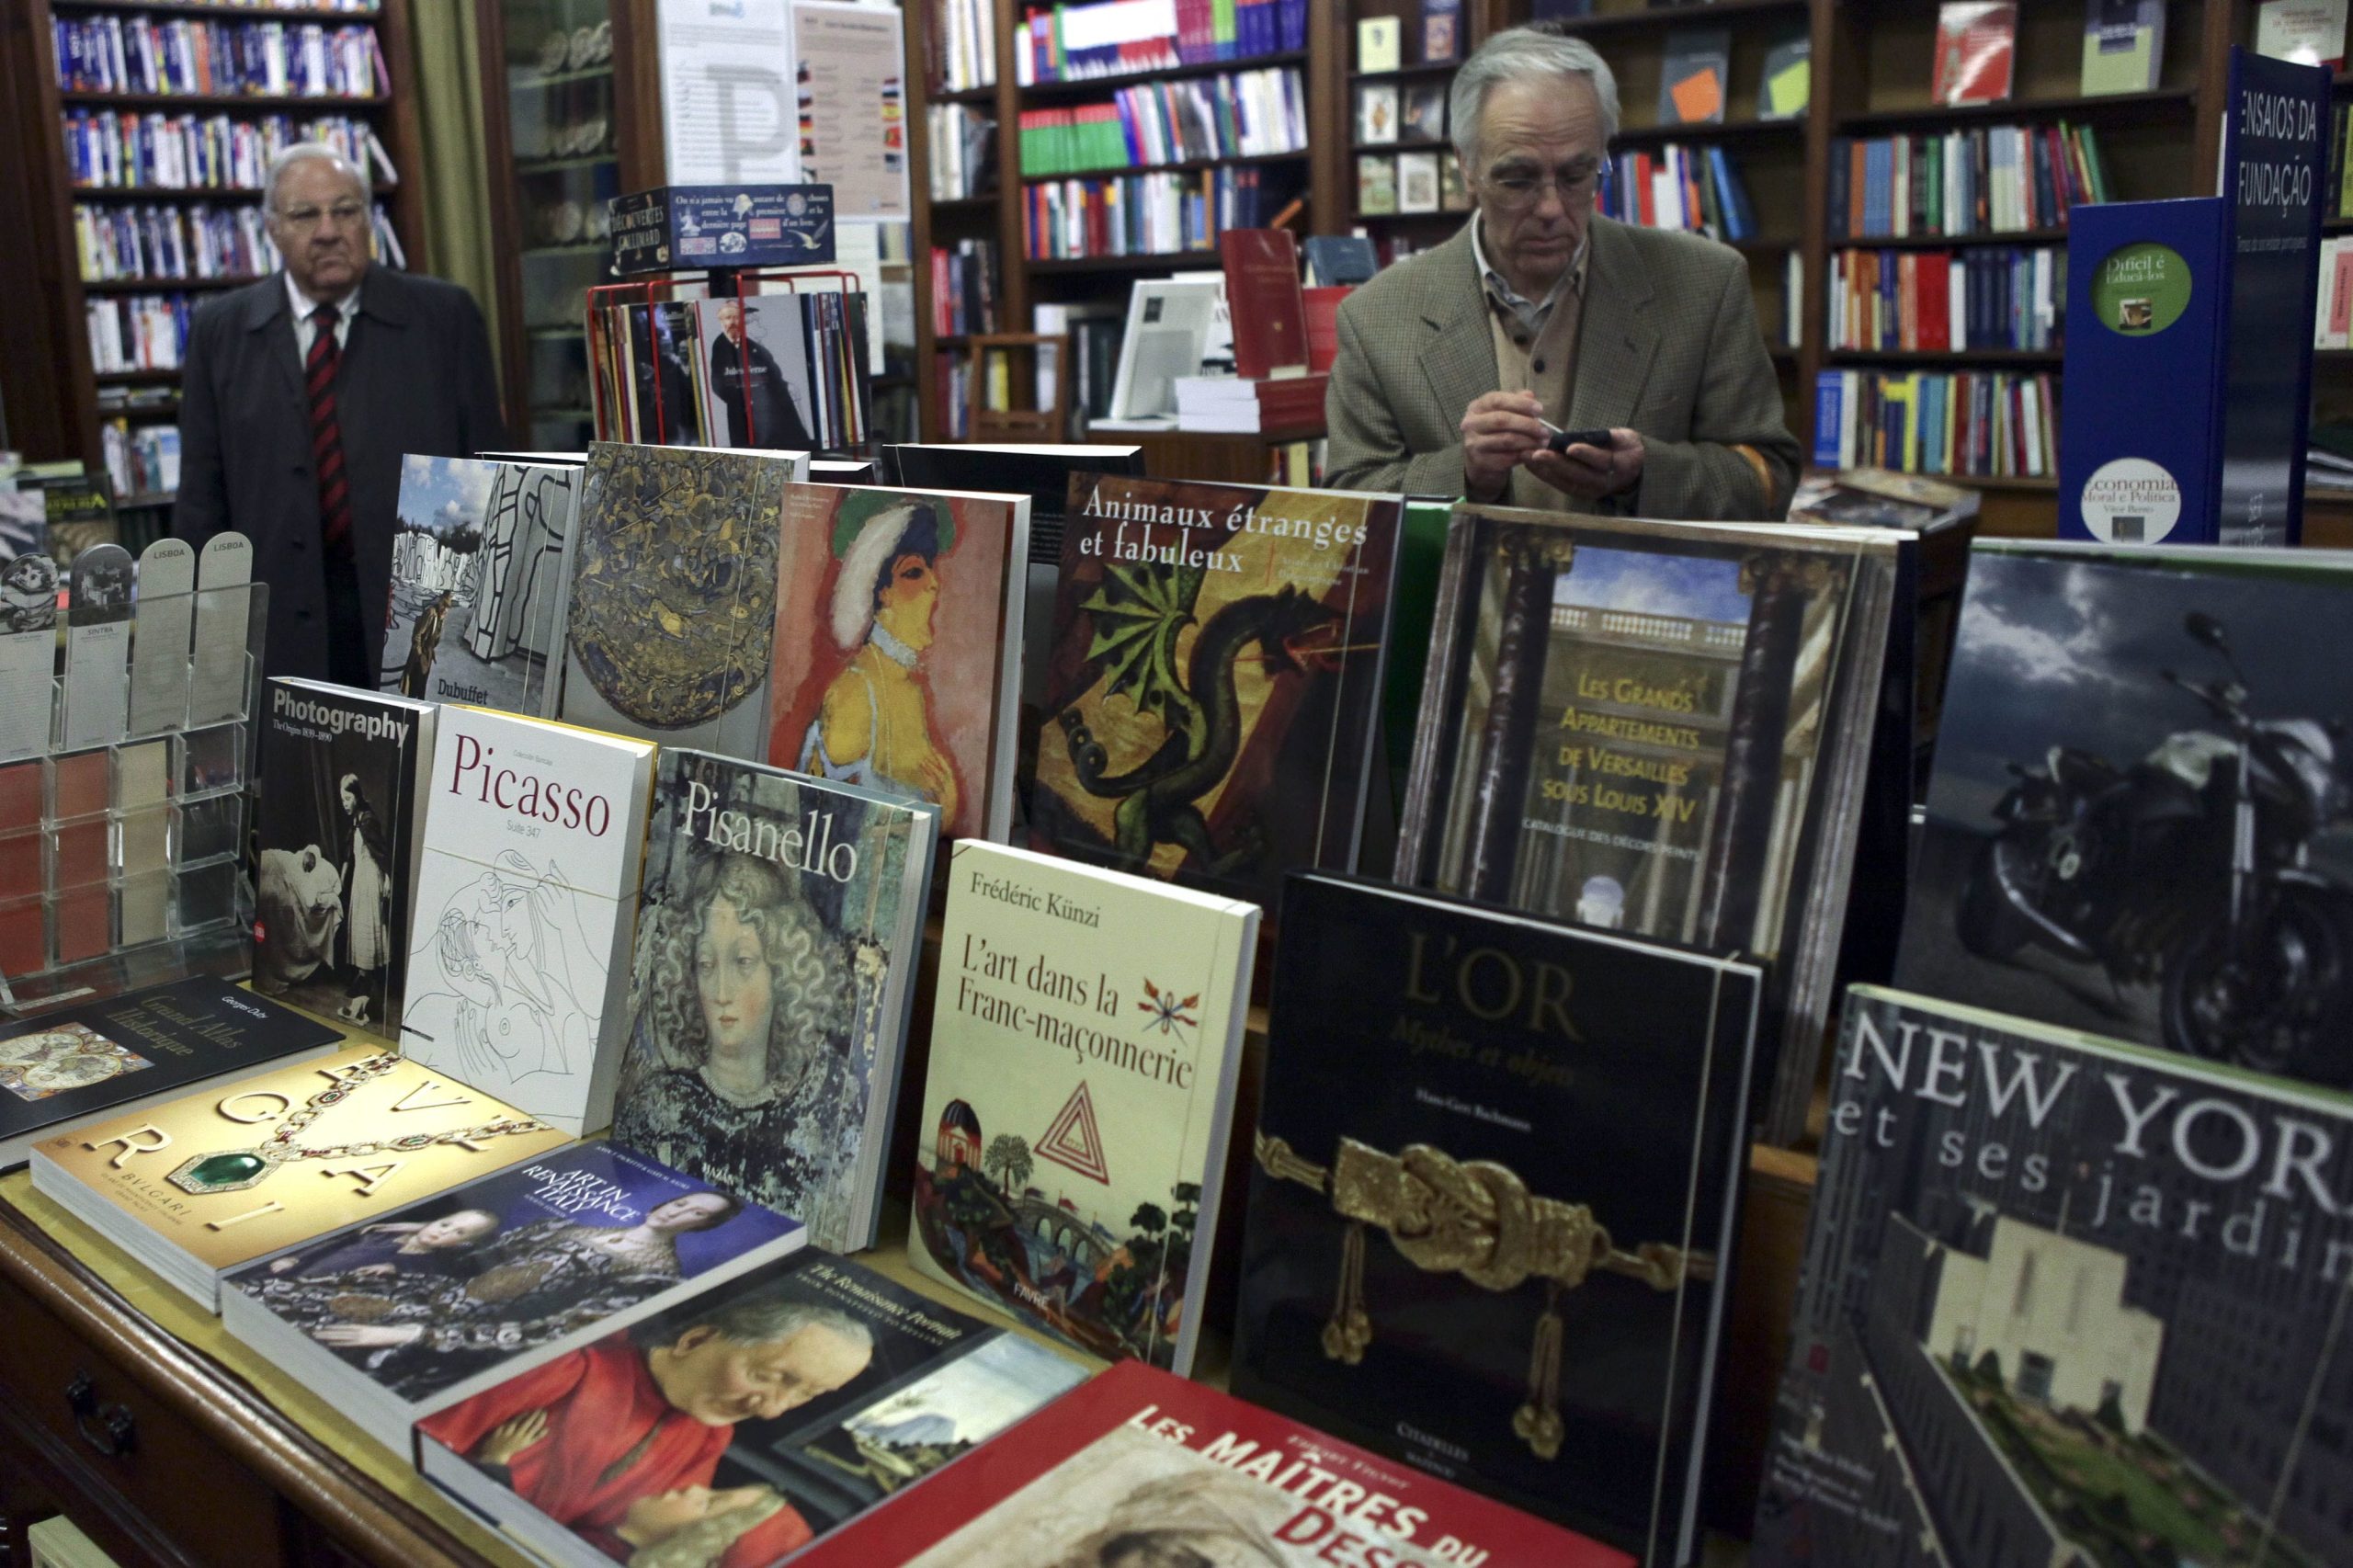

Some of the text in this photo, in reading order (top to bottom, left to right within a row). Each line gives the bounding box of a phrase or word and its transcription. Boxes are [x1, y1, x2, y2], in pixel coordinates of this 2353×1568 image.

[2298, 99, 2316, 142] DA
[676, 196, 689, 205] On
[754, 195, 775, 204] autant
[776, 195, 784, 203] de
[2237, 154, 2312, 218] FUNDAÇÃO
[701, 209, 720, 217] entre
[721, 207, 727, 216] la
[2156, 255, 2165, 268] é
[1083, 484, 1369, 551] Animaux étranges
[153, 549, 186, 560] LISBOA
[214, 541, 244, 552] LISBOA
[1080, 529, 1103, 556] et
[1113, 521, 1245, 574] fabuleux
[87, 626, 113, 636] SINTRA
[438, 678, 489, 706] Dubuffet
[273, 688, 410, 748] Photography
[273, 719, 283, 732] The
[449, 733, 610, 837] Picasso
[1653, 793, 1697, 823] XIV
[506, 819, 541, 838] Suite 347
[682, 780, 858, 882] Pisanello
[971, 870, 1101, 928] Frédéric Künzi
[961, 933, 1120, 1017] L'art dans la
[1404, 931, 1588, 1044] L'OR
[141, 995, 246, 1050] Grand Atlas
[222, 995, 250, 1013] Georges
[106, 1007, 194, 1056] Historique
[957, 975, 1193, 1090] Franc-maçonnerie
[1843, 1010, 2353, 1219] NEW YOR
[1835, 1097, 1895, 1149] et
[1938, 1127, 2051, 1194] ses
[121, 1172, 192, 1217] BVLGARI
[522, 1165, 641, 1221] RENAISSANCE
[534, 1185, 594, 1213] ITALY
[563, 1169, 631, 1201] ART IN
[1126, 1403, 1195, 1446] LES
[1198, 1430, 1430, 1541] MAÎTRES
[1430, 1535, 1490, 1568] DU
[1273, 1505, 1421, 1568] DES
